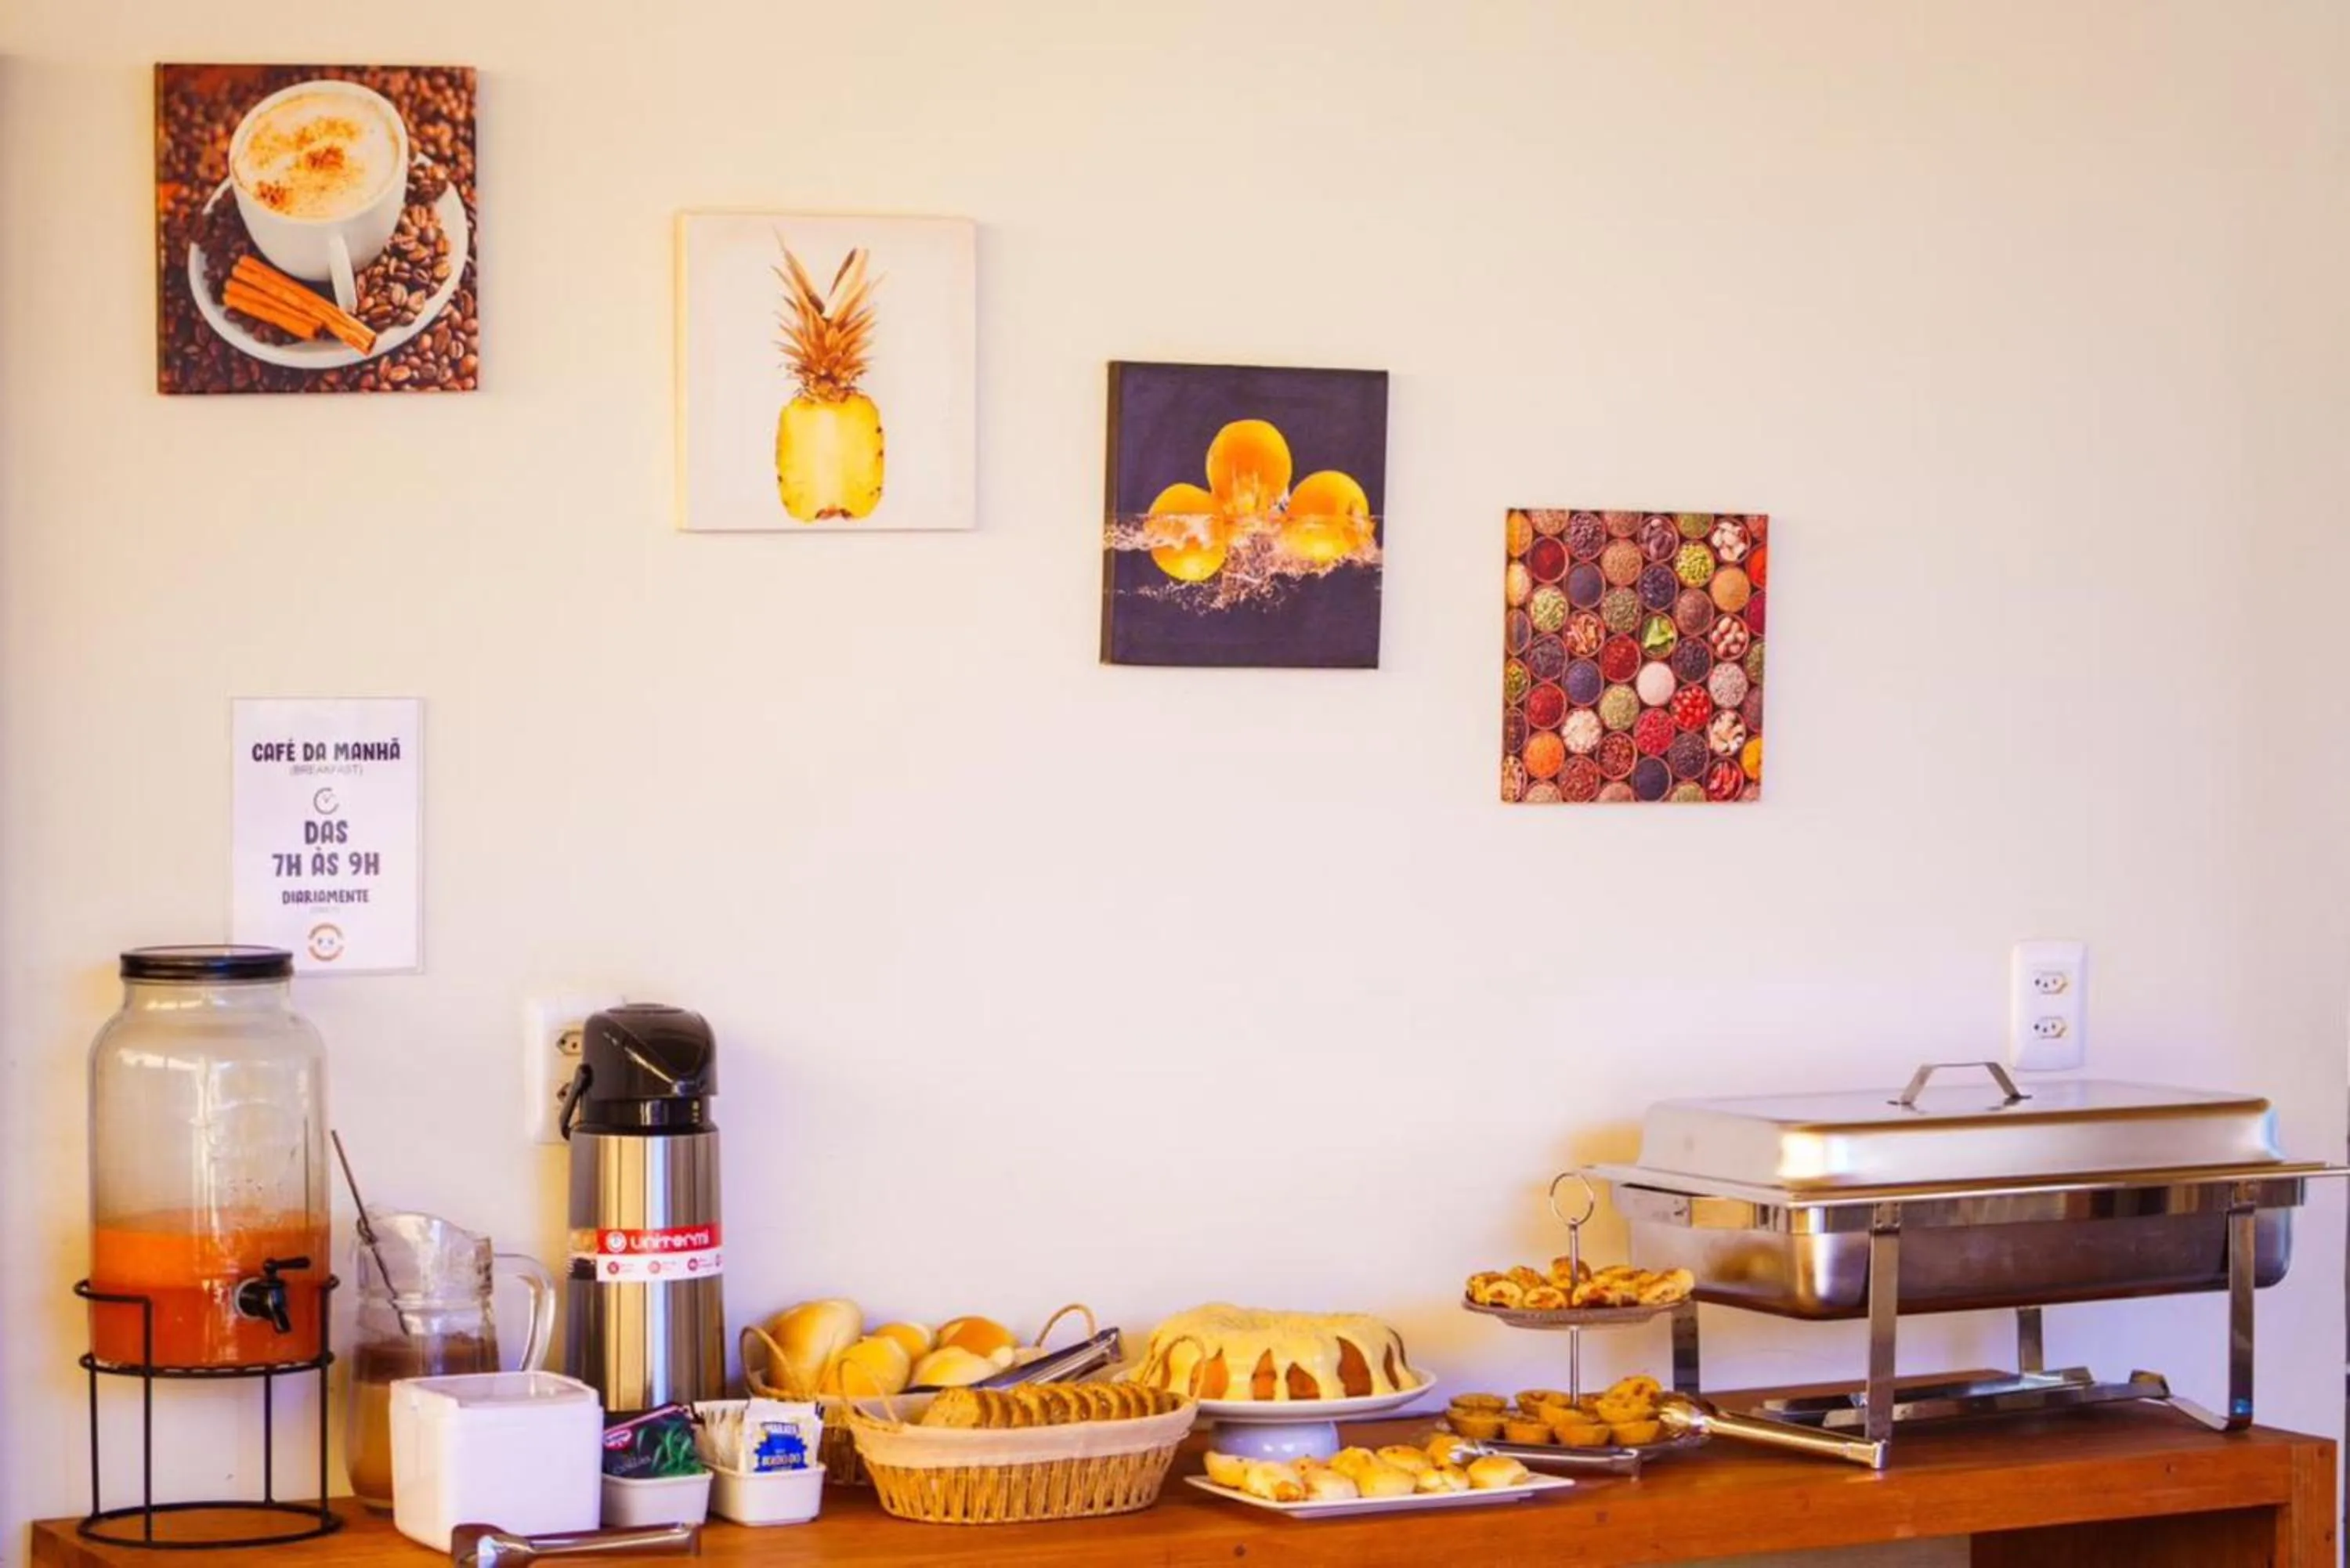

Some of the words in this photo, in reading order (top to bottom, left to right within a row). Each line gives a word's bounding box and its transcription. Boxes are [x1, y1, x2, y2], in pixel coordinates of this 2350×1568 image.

[252, 739, 295, 762] CAFÉ
[303, 743, 326, 761] DA
[334, 738, 401, 761] MANHÃ
[305, 821, 349, 844] DAS
[272, 854, 302, 876] 7H
[349, 852, 379, 875] 9H
[282, 889, 369, 905] DIARIAMENTE
